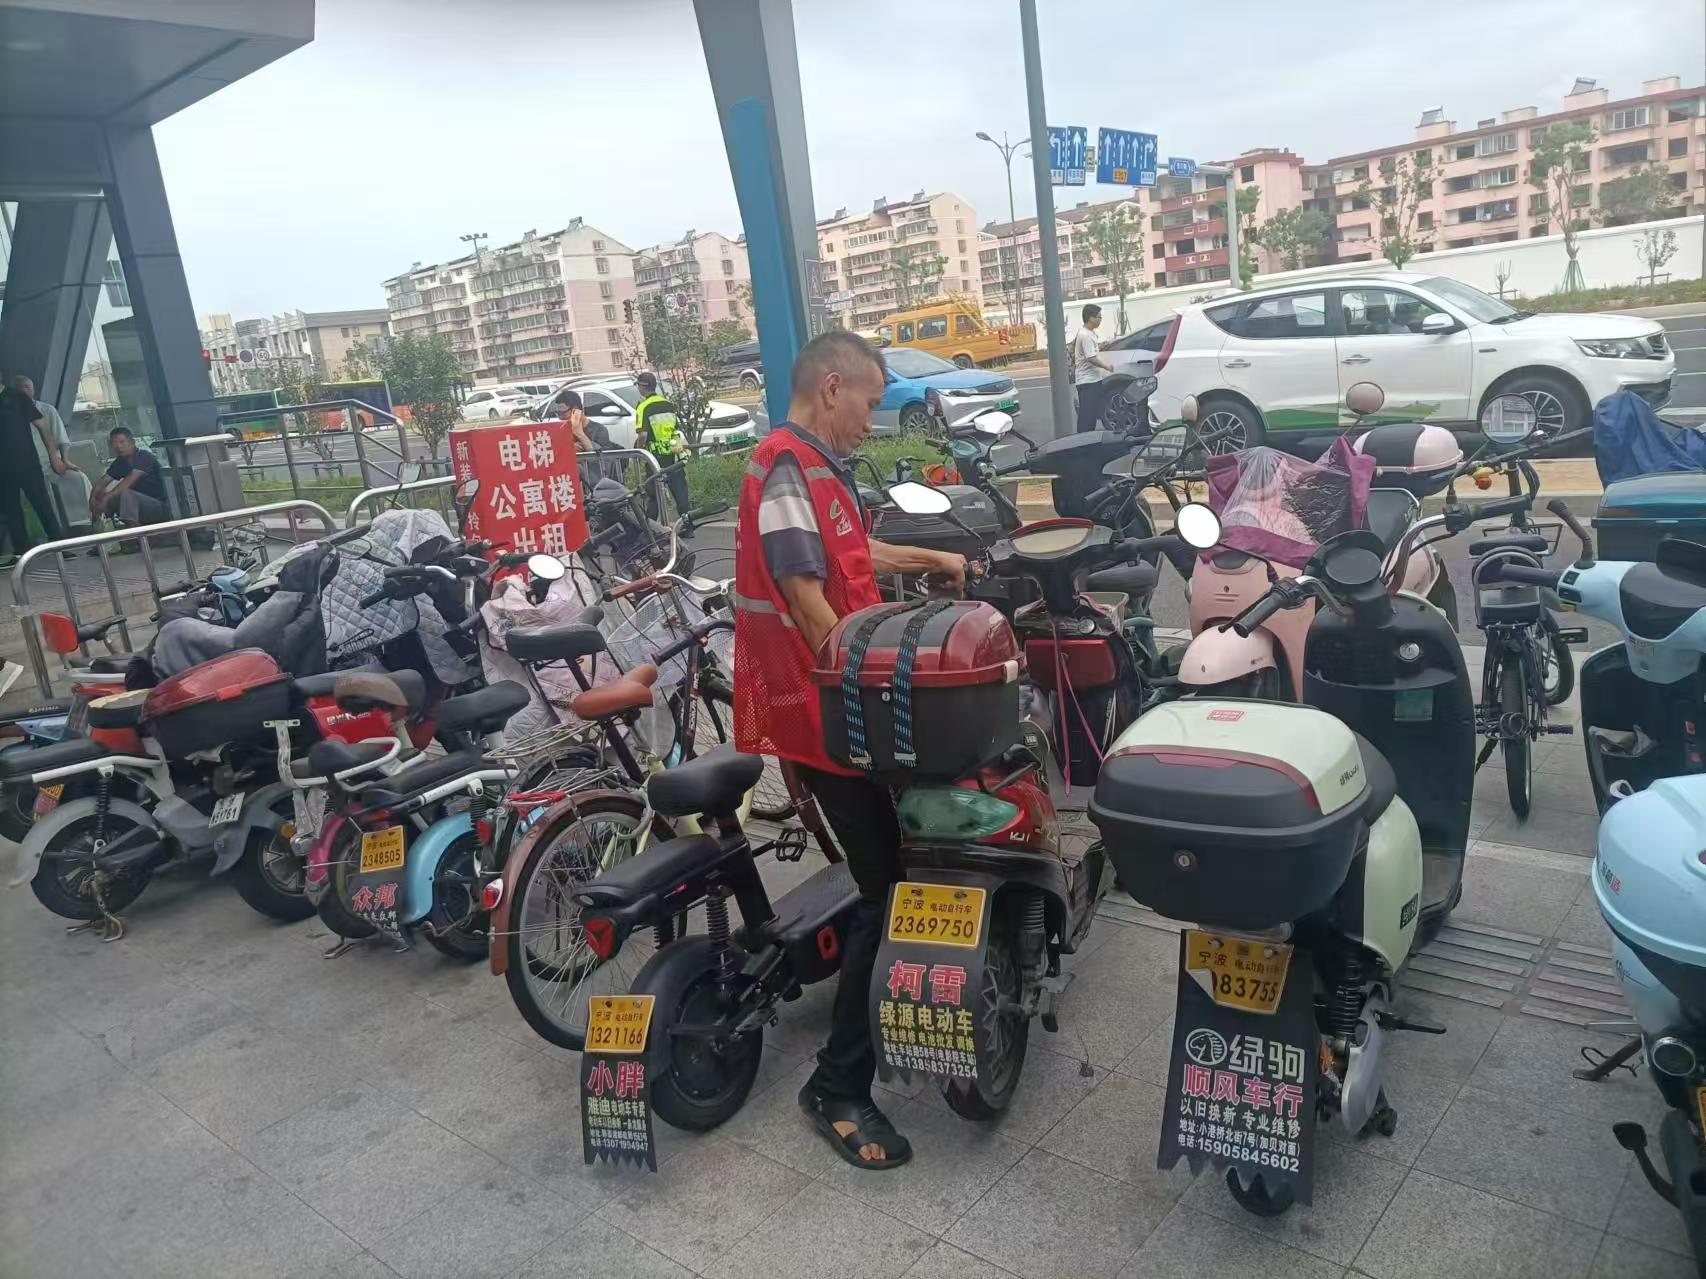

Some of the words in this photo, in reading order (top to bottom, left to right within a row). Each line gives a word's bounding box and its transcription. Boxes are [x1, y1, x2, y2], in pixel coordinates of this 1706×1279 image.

[498, 430, 556, 471] 电梯
[489, 474, 577, 520] 公寓楼
[513, 523, 568, 555] 出租
[352, 882, 399, 912] 众邦
[903, 899, 924, 910] 宁波
[930, 903, 972, 914] 电动自行车
[894, 916, 974, 938] 2369750
[1199, 951, 1227, 966] 宁波
[887, 960, 967, 1005] 柯雷
[590, 1027, 643, 1044] 1321166
[879, 1000, 974, 1036] 绿源电动车
[881, 1026, 916, 1045] 专业维修
[918, 1031, 954, 1049] 电池批发
[1228, 1034, 1306, 1083] 绿驹
[587, 1060, 645, 1098] 小胖
[1181, 1064, 1304, 1118] 顺风车行
[1180, 1097, 1236, 1126] 以旧换新
[1242, 1110, 1301, 1139] 专业维修
[1177, 1133, 1300, 1173] 电话:15905845602
